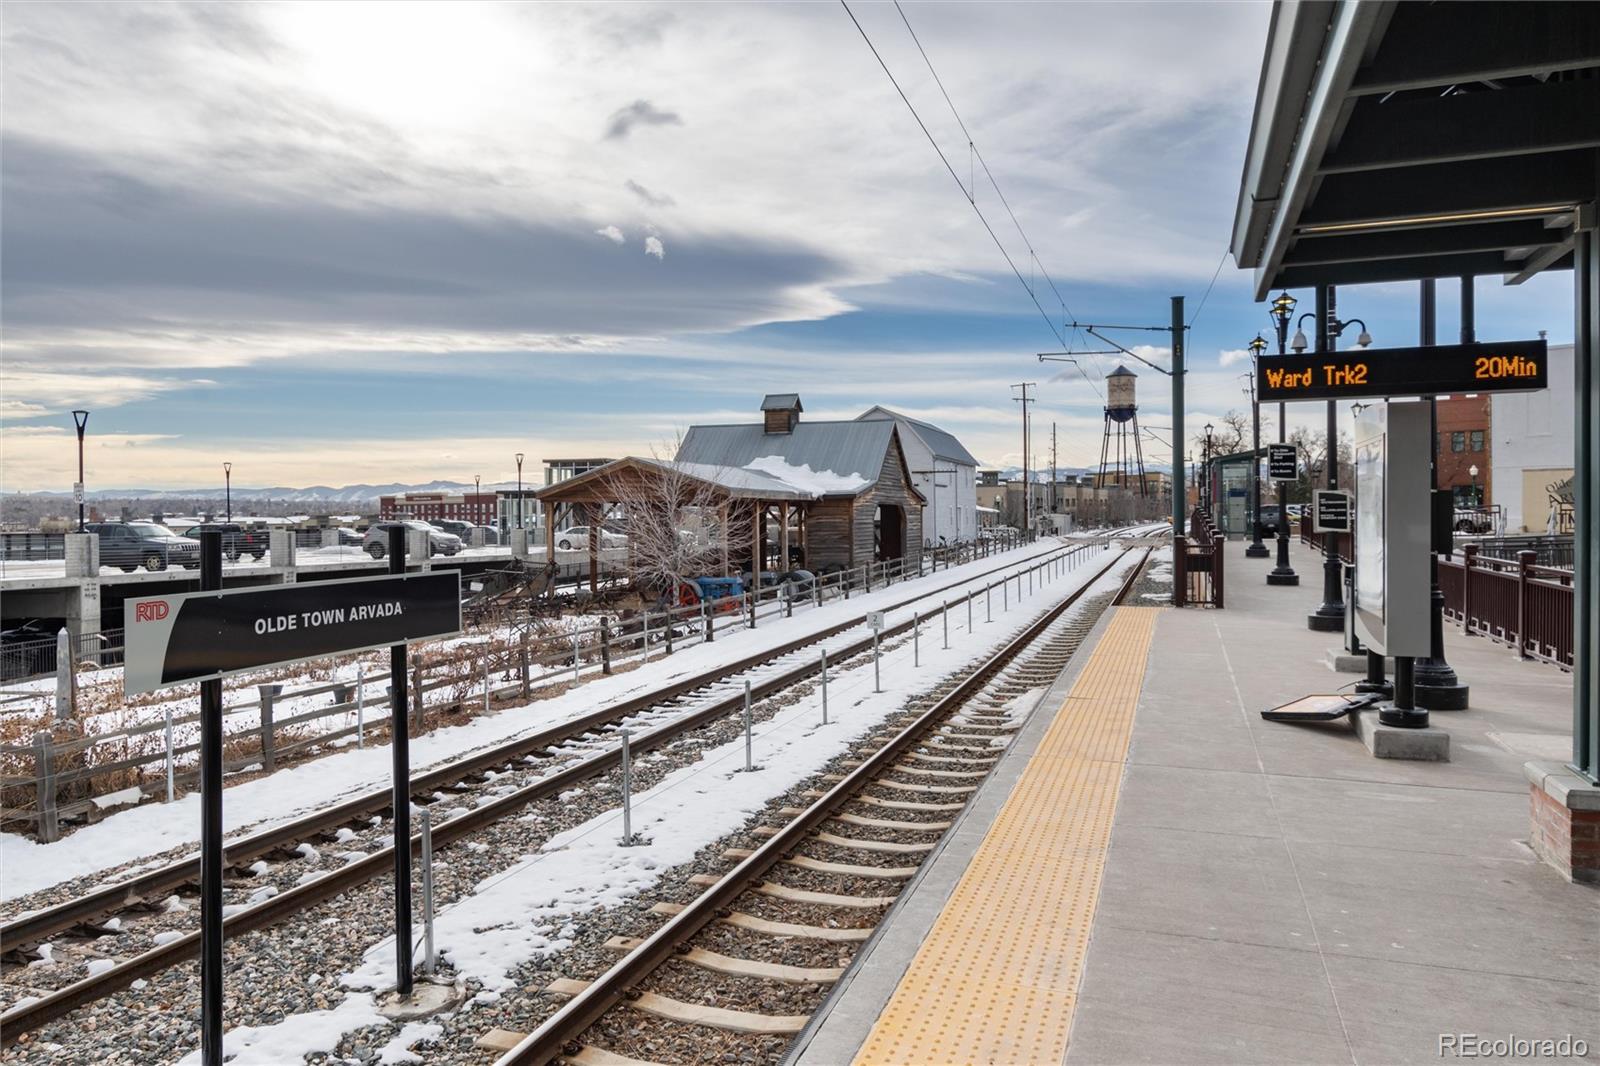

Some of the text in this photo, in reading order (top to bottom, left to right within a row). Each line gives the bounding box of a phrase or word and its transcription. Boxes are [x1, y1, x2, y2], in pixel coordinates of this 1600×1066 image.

[1267, 356, 1537, 388] Ward Trk2 20Min
[136, 600, 170, 622] RTD
[254, 602, 403, 635] OLDE TOWN ARVADA
